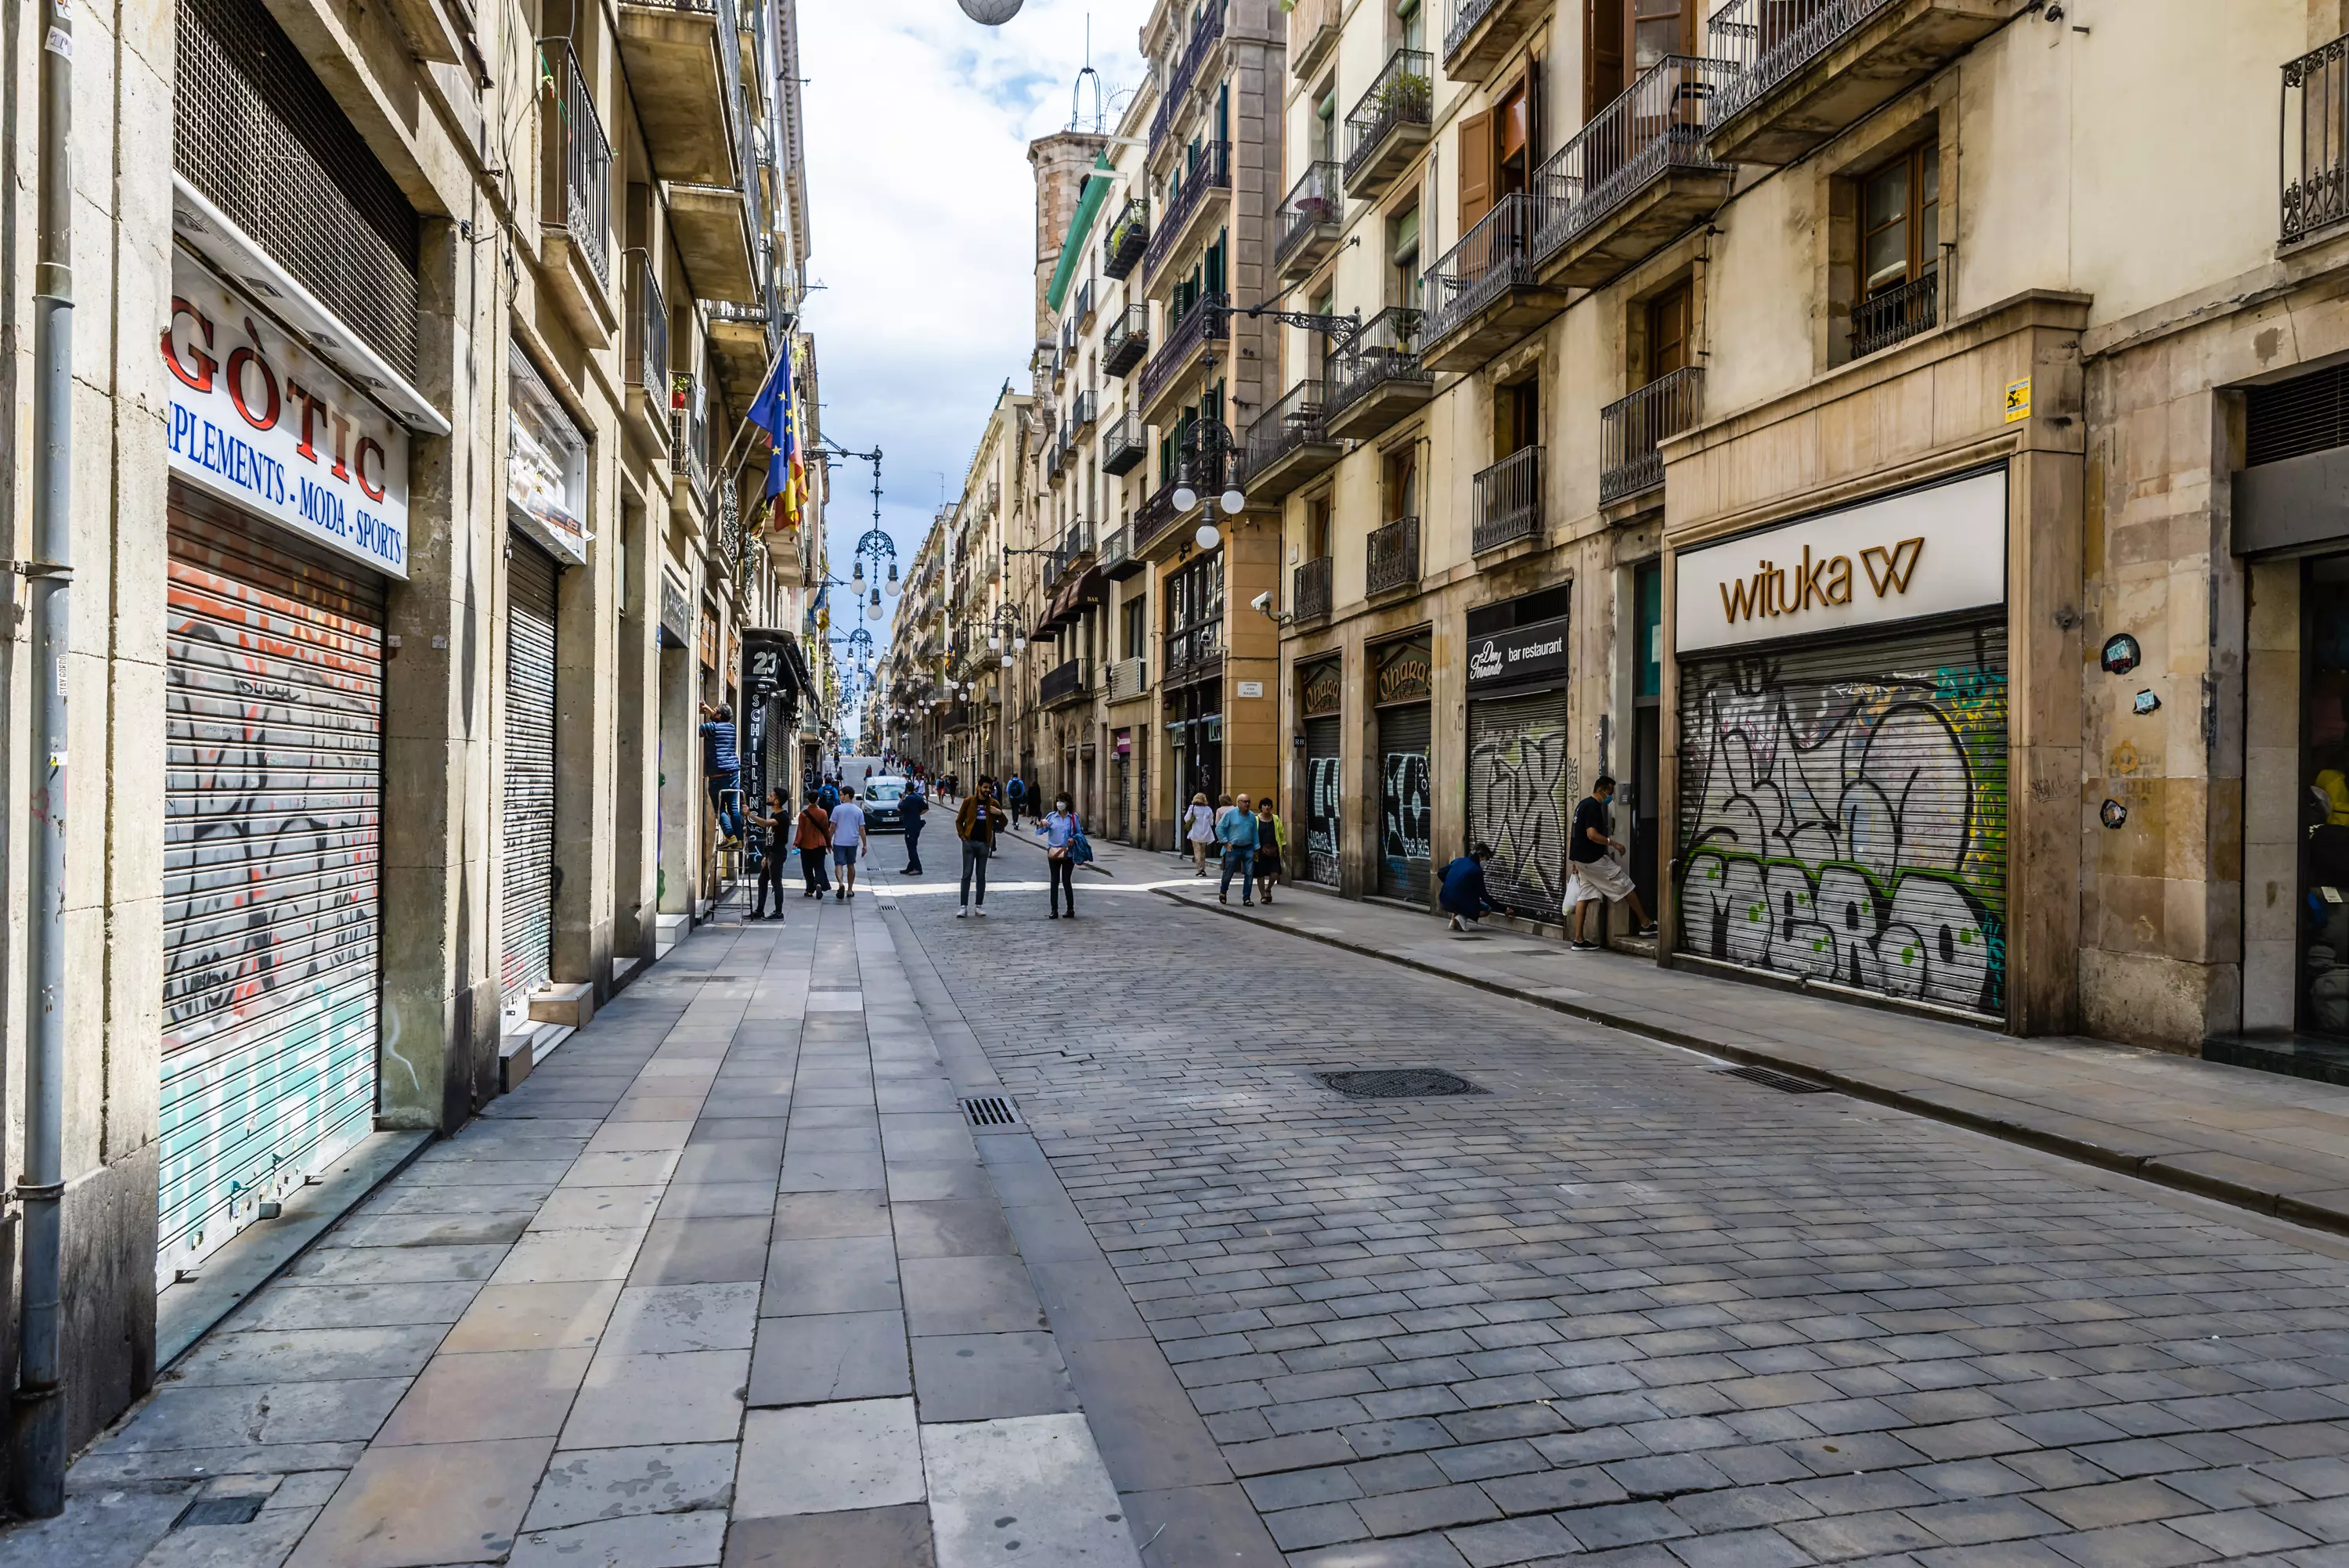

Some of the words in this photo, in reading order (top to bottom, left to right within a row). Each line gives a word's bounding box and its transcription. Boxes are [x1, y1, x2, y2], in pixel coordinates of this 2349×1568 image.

[161, 295, 386, 505] GÒTIC
[299, 476, 346, 538] MODA
[356, 510, 402, 565] SPORTS
[1719, 544, 1853, 624] wituka
[59, 678, 67, 695] STAY
[1508, 647, 1521, 662] bar
[1522, 636, 1562, 660] restaurant
